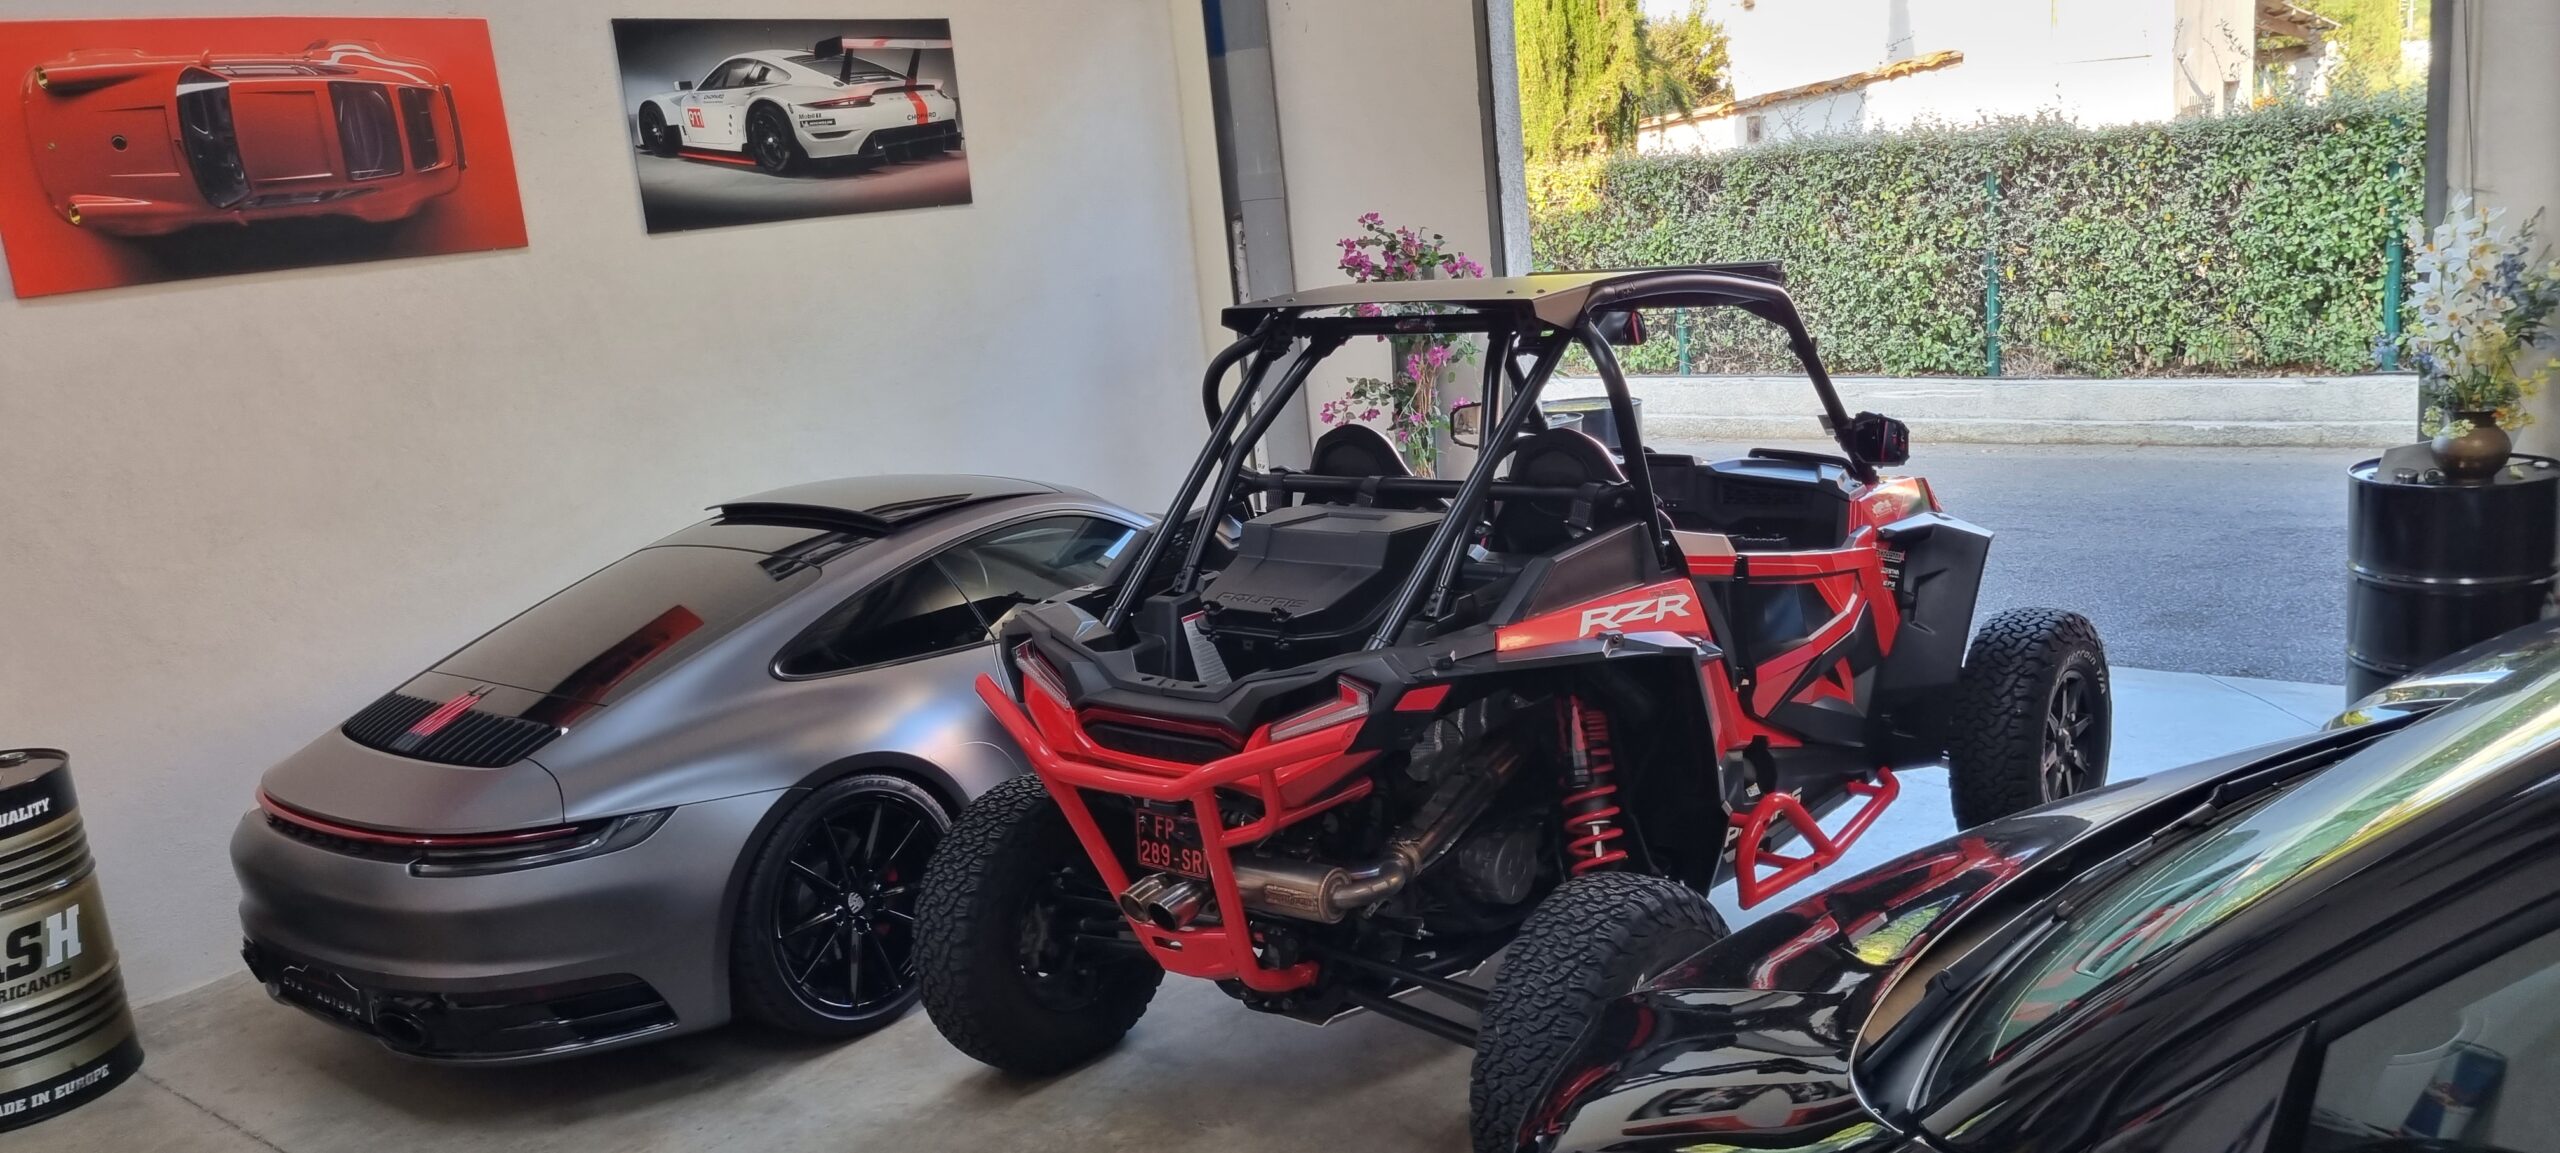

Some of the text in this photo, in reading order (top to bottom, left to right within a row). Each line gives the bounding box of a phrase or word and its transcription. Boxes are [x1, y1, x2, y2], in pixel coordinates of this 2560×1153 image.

[688, 110, 704, 126] 911
[907, 111, 937, 121] CHOPARD
[1216, 592, 1309, 608] POLARIS
[1579, 594, 1691, 638] RZR
[1141, 840, 1203, 873] 289-SR
[0, 904, 82, 983] SH
[30, 1090, 51, 1108] IN
[54, 1064, 111, 1099] EUROPE
